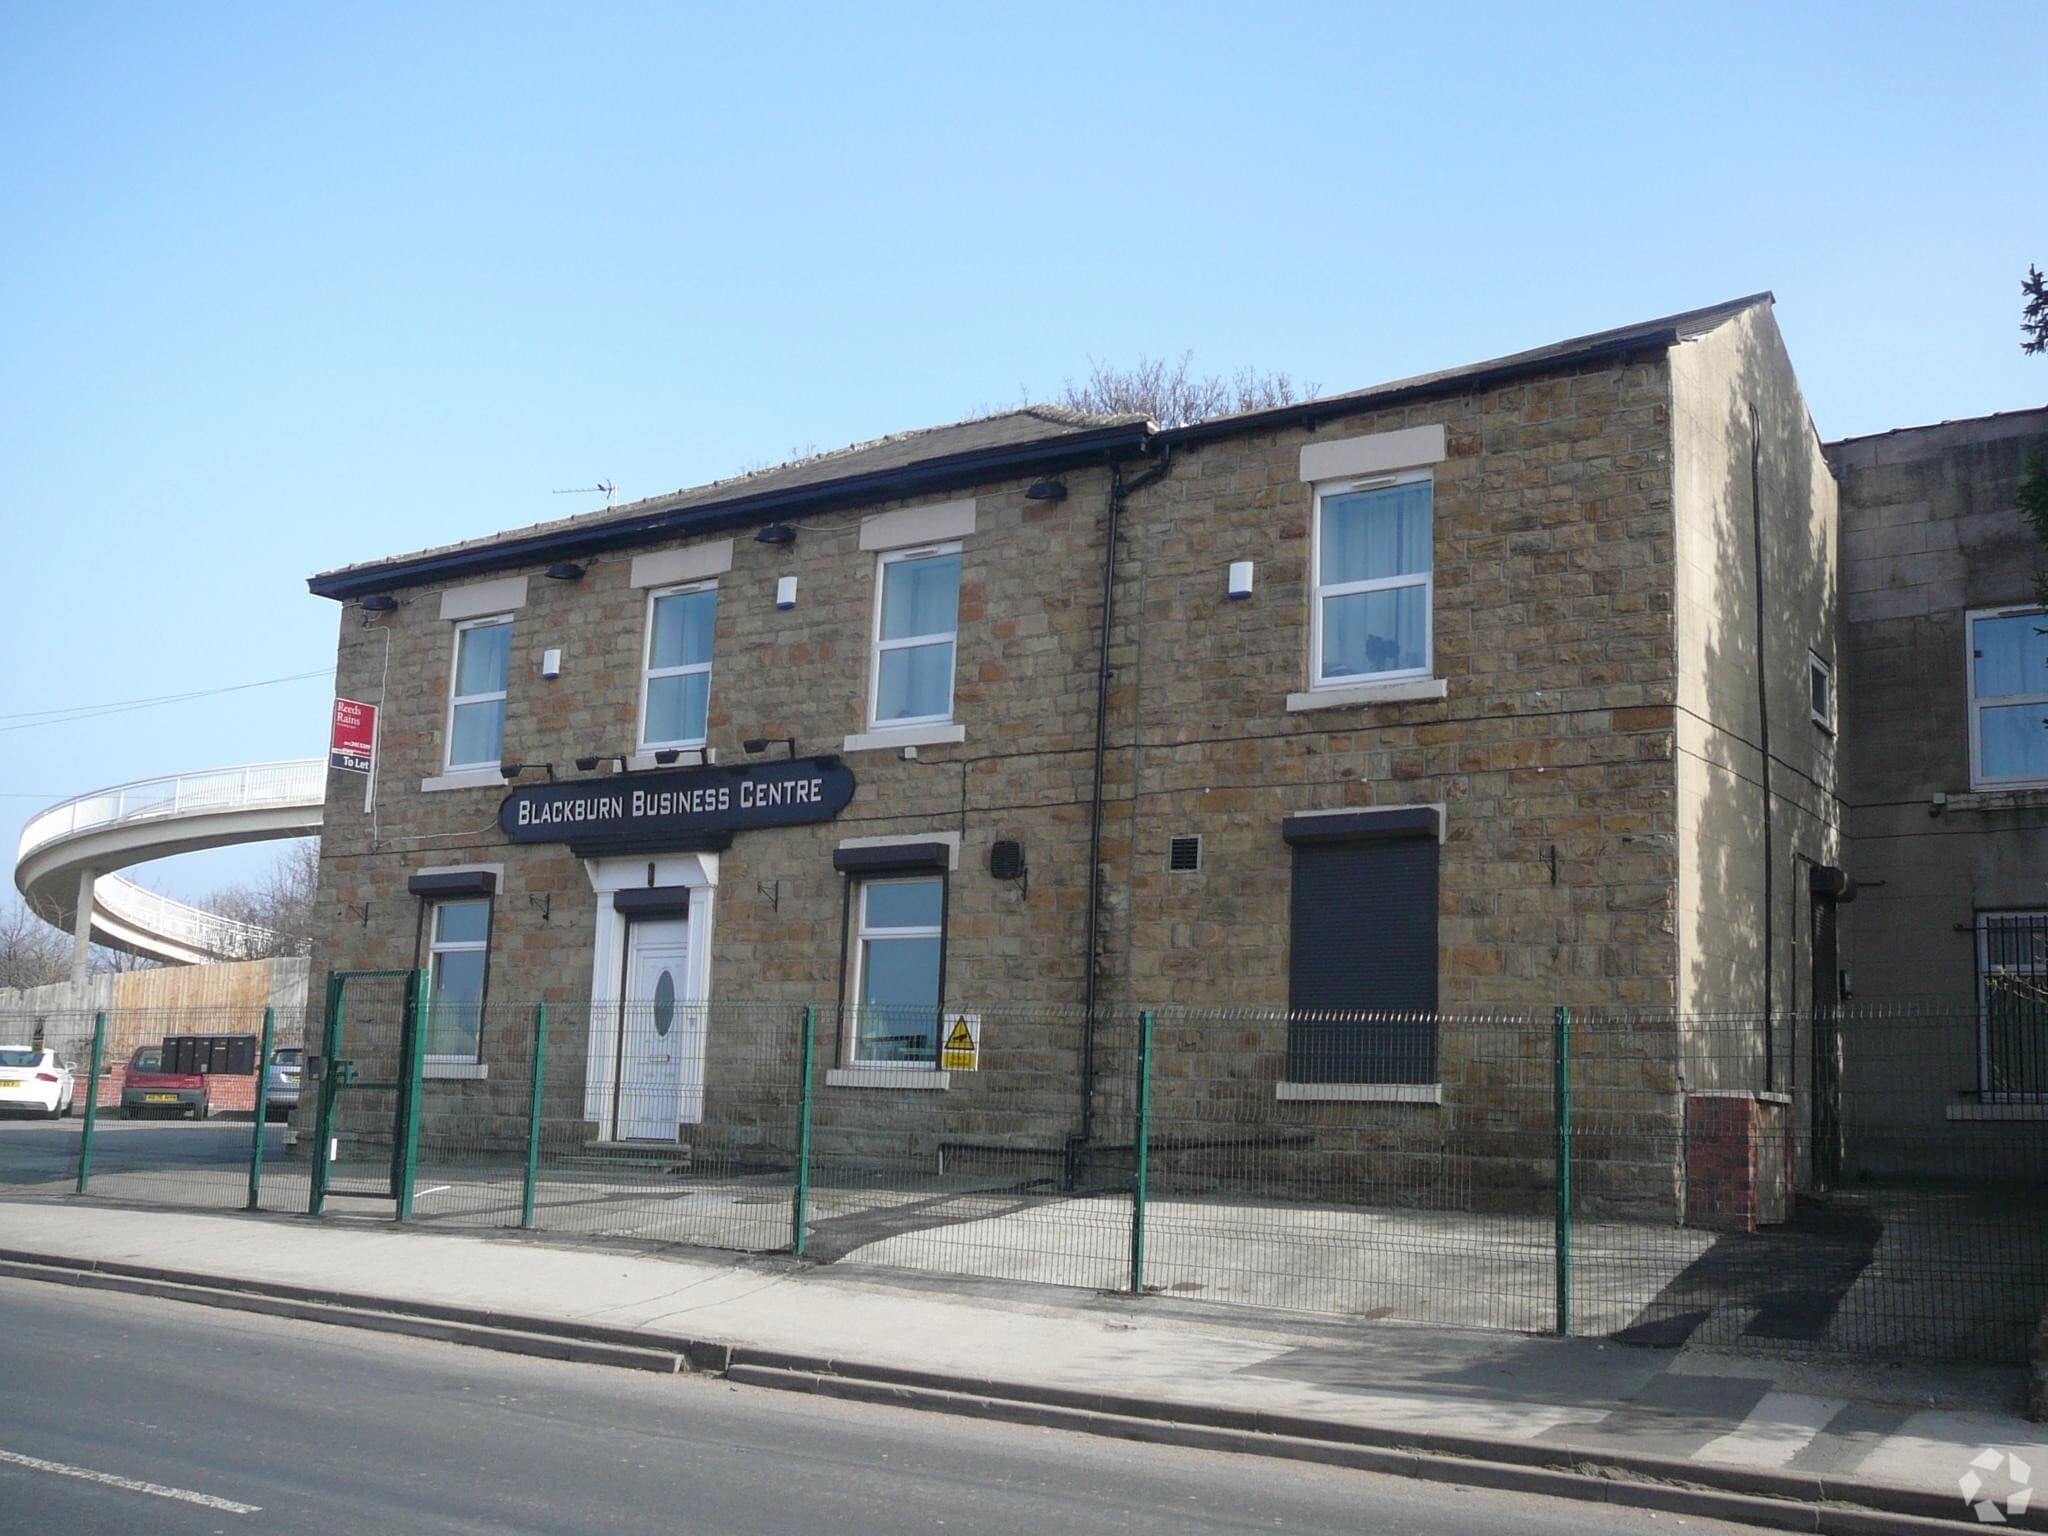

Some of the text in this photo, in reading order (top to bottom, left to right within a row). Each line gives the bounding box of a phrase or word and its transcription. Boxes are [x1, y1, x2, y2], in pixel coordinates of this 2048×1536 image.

[337, 701, 362, 715] Reeds
[337, 711, 361, 726] Rains
[343, 756, 369, 769] To Let
[518, 778, 822, 825] BLACKBURN BUSINESS CENTRE
